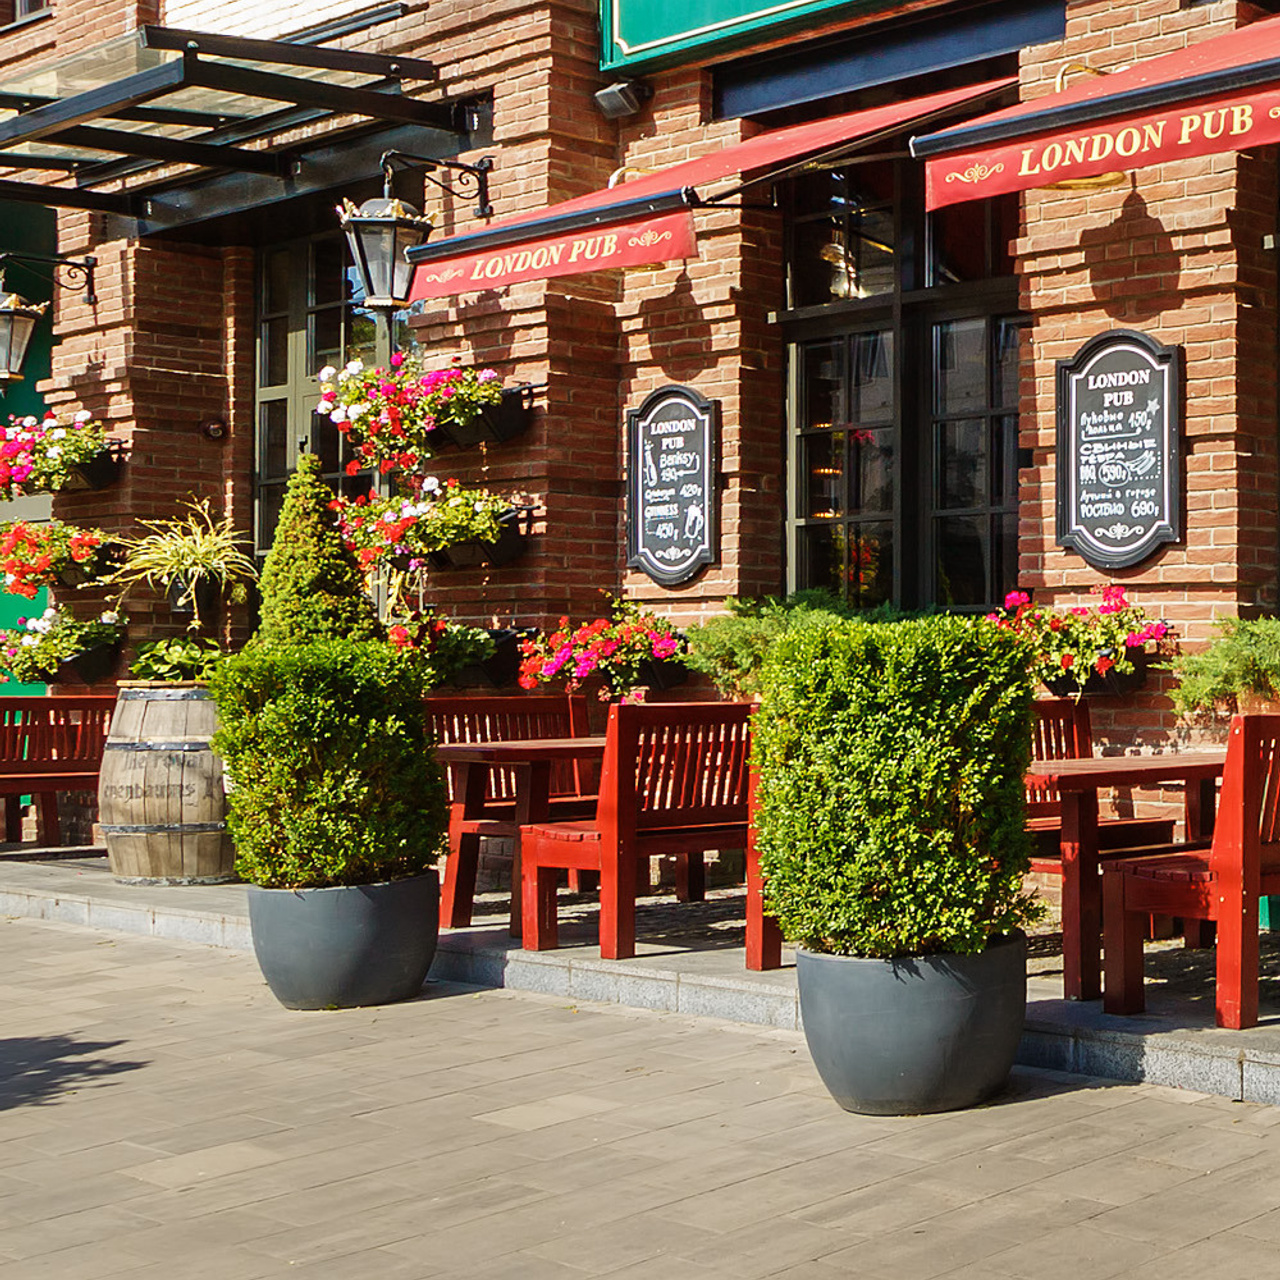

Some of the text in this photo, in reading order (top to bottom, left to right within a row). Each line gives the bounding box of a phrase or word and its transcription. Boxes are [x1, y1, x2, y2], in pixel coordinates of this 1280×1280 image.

[1017, 104, 1253, 176] LONDON PUB
[470, 243, 564, 280] LONDON
[1087, 369, 1150, 390] LONDON
[1103, 391, 1134, 407] PUB
[650, 418, 696, 435] LONDON
[661, 436, 684, 450] PUB
